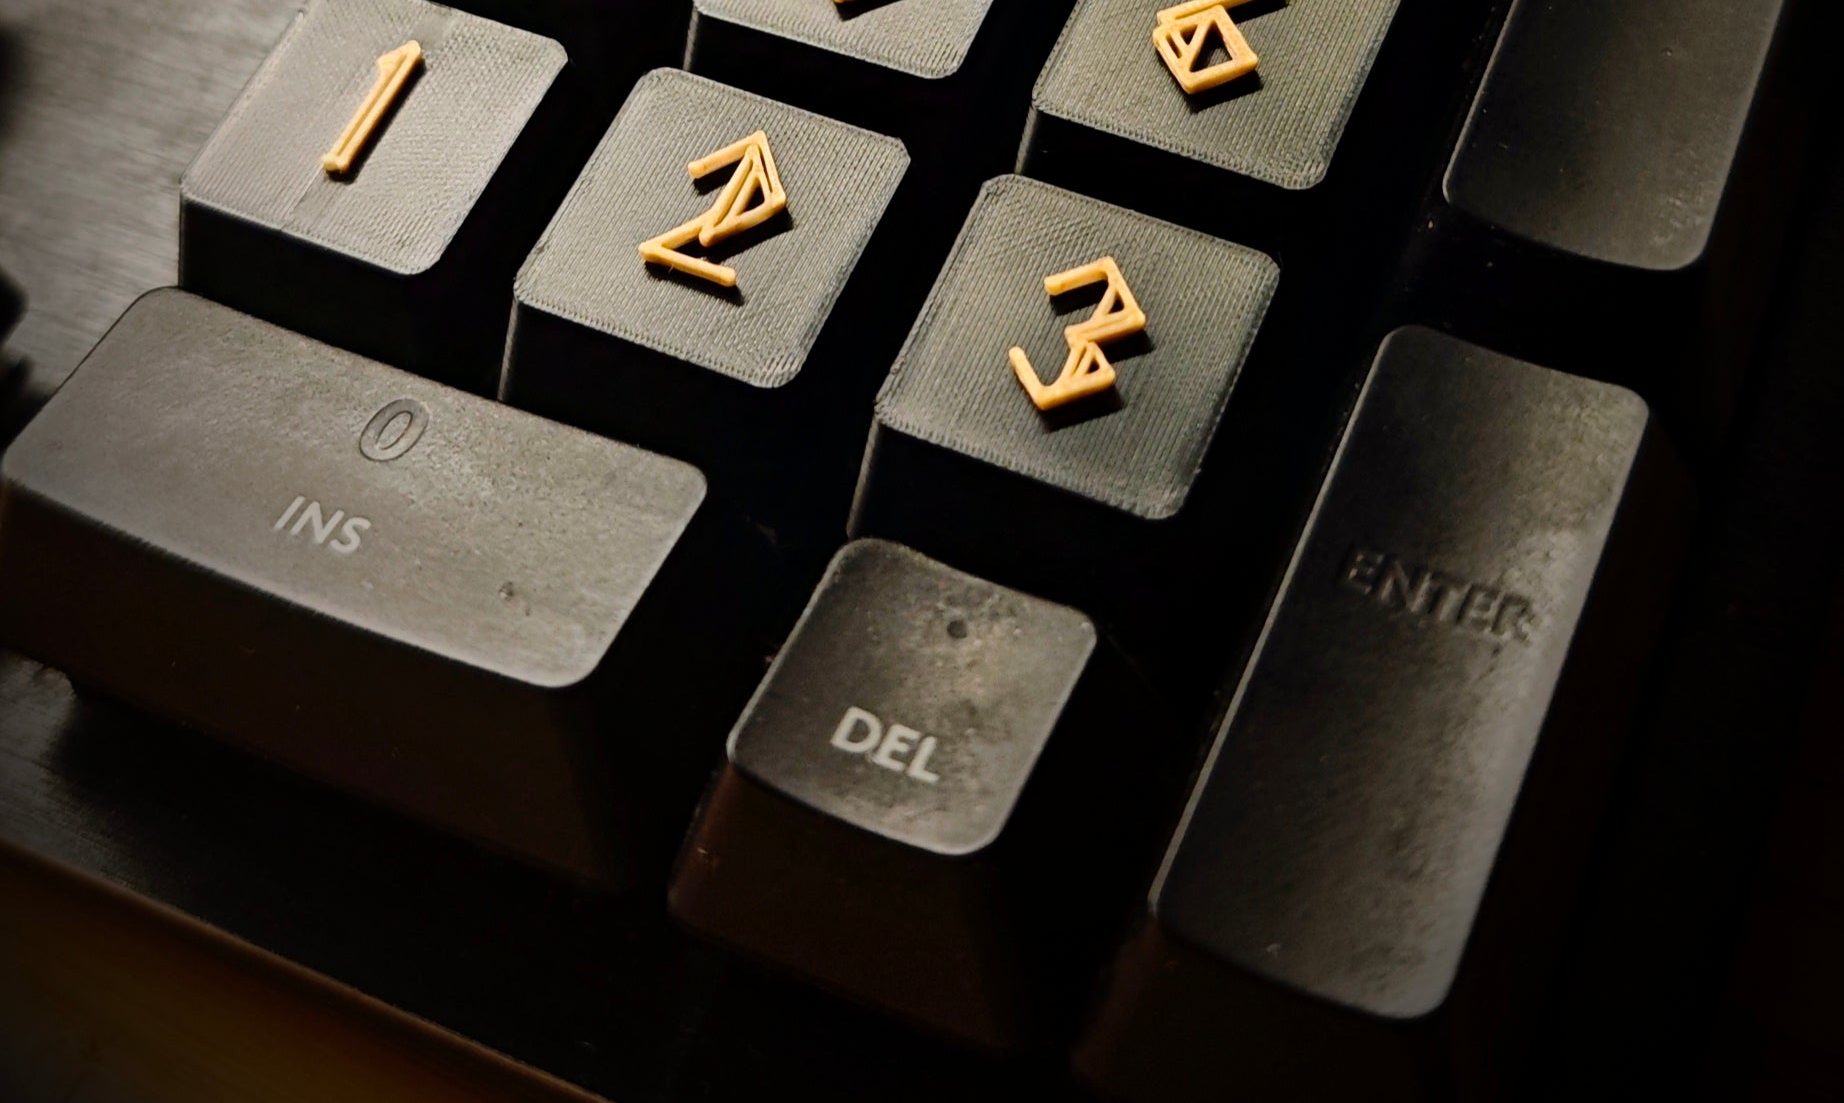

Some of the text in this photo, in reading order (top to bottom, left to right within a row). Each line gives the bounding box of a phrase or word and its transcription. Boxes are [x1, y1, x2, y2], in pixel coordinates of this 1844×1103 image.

[322, 39, 422, 175] 1
[638, 129, 789, 287] 2
[1008, 254, 1148, 410] 3
[358, 397, 430, 463] 0
[273, 495, 372, 554] INS
[1341, 545, 1535, 641] ENTER
[830, 706, 940, 784] DEL
